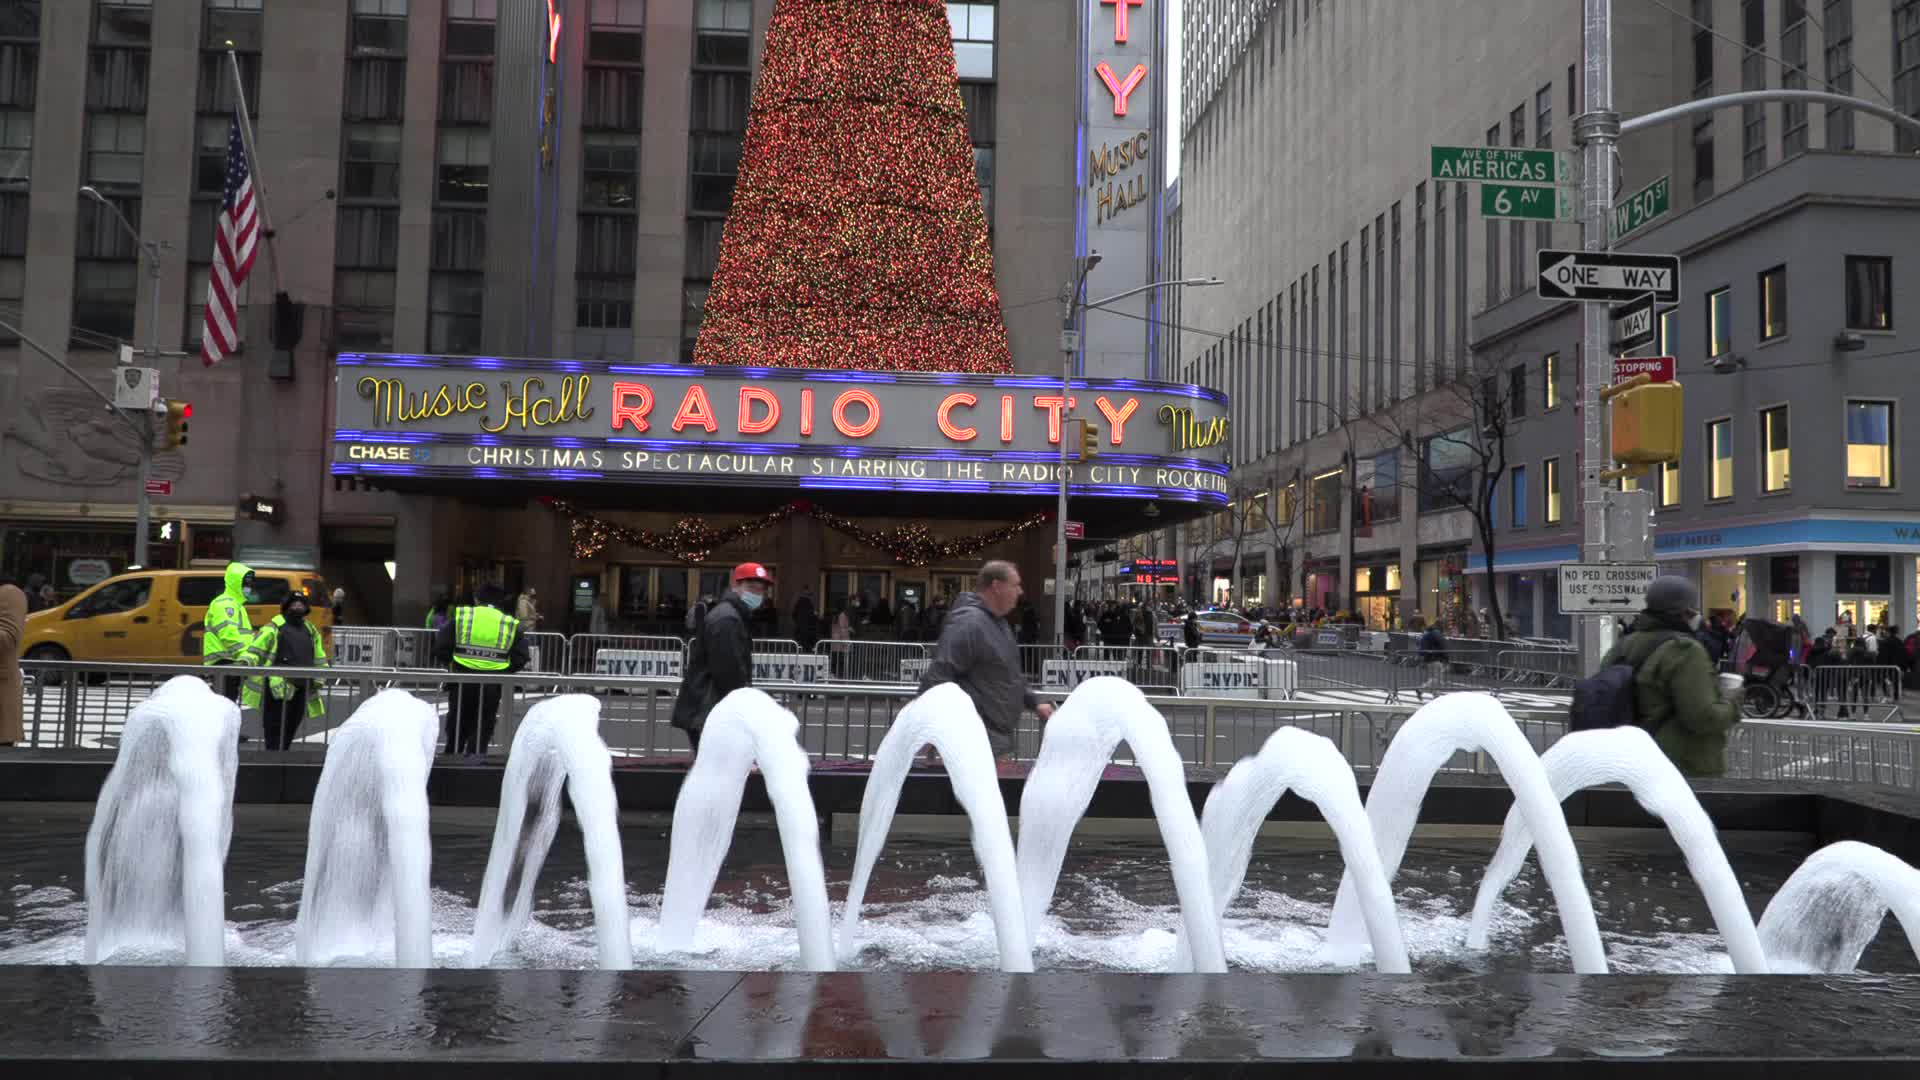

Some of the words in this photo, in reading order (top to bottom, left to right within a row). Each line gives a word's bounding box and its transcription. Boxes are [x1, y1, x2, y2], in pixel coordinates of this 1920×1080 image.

[1089, 132, 1149, 188] MUSIC
[1461, 150, 1483, 160] AVE
[1486, 150, 1500, 161] OF
[1504, 151, 1524, 161] THE
[1439, 160, 1547, 180] AMERICAS
[1097, 174, 1147, 226] HALL
[1494, 188, 1512, 214] 6
[1520, 190, 1540, 203] AV
[1616, 205, 1632, 231] W
[1633, 191, 1654, 222] 50
[1655, 181, 1667, 199] ST
[1557, 266, 1599, 285] ONE
[1622, 268, 1667, 288] WAY
[1622, 308, 1649, 336] WAY
[1614, 361, 1662, 373] STOPPING
[357, 375, 487, 427] Music
[480, 375, 593, 432] Hall
[611, 382, 880, 438] RADIO
[937, 392, 1139, 444] CITY
[349, 446, 411, 461] CHASE
[468, 447, 602, 468] CHRISTMAS
[622, 452, 793, 473] SPECTACULAR
[812, 457, 925, 477] STARRING
[946, 461, 984, 480] THE
[1003, 463, 1073, 482] RADIO
[1091, 466, 1141, 484] CITY
[1565, 570, 1578, 581] NO
[1582, 570, 1600, 581] PED
[1606, 570, 1653, 581] CROSSING
[1569, 584, 1587, 594] USE
[608, 660, 669, 676] NYPD
[1212, 672, 1252, 687] NYPD
